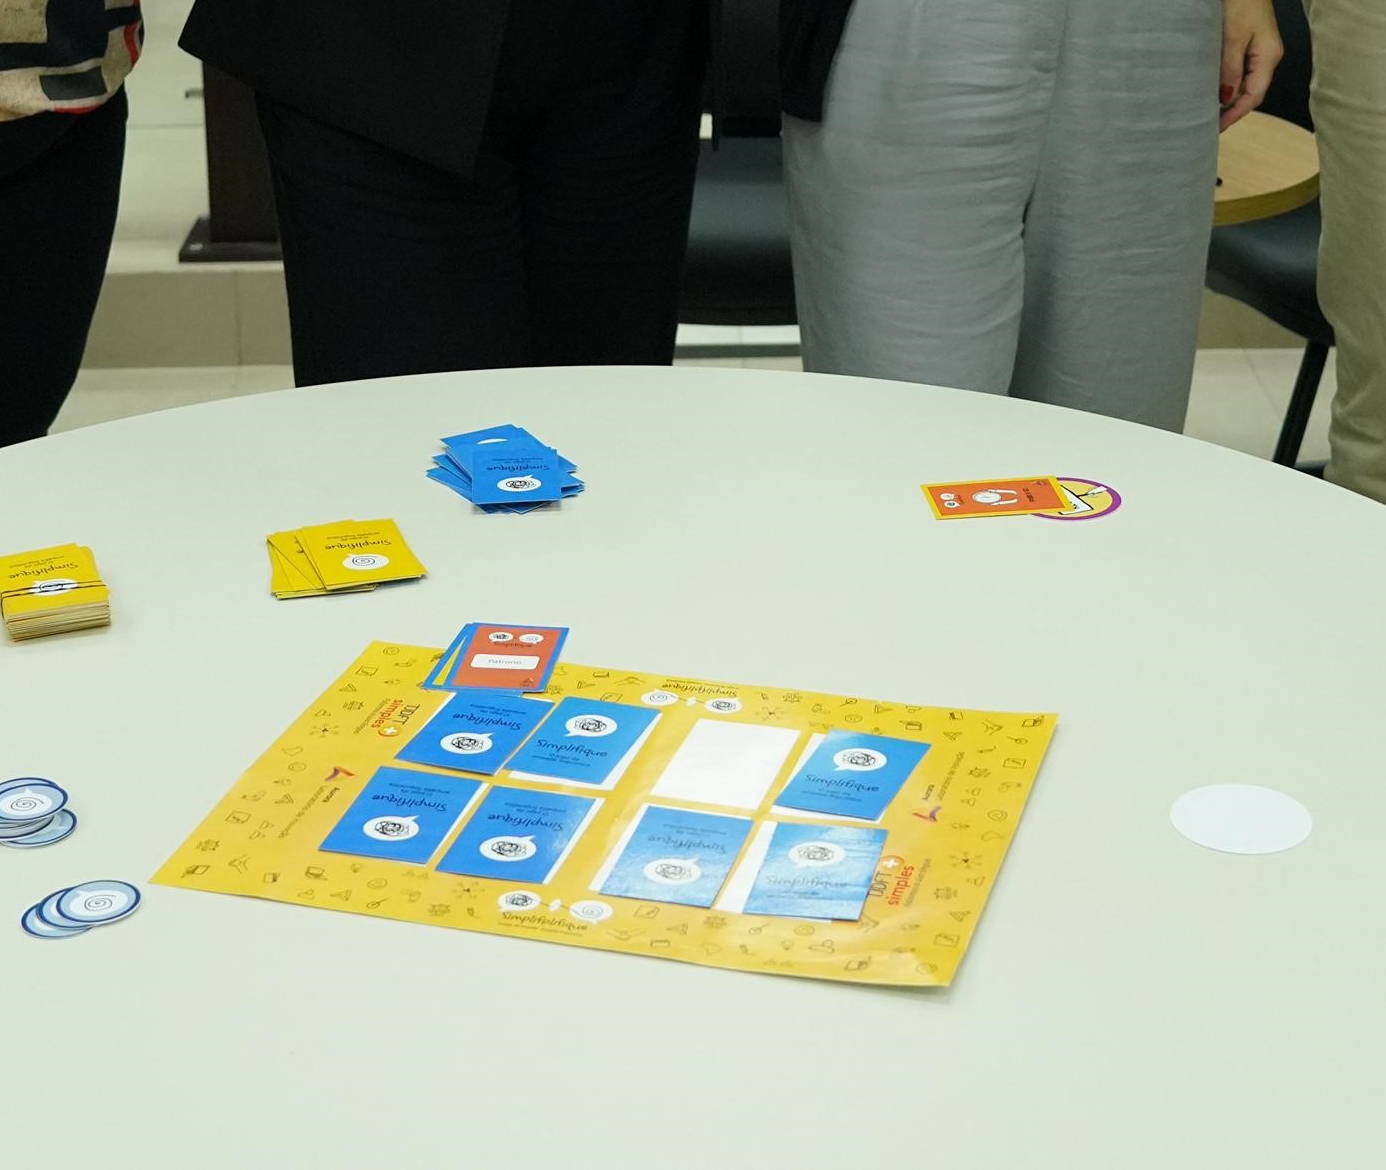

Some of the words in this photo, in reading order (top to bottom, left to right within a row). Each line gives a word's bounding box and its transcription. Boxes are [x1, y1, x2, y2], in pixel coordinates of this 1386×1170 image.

[325, 539, 391, 551] Simplifique
[7, 561, 78, 580] Simplifique
[452, 712, 522, 731] Simplifique
[536, 739, 608, 758] Simplifique
[805, 773, 880, 792] Simplifique
[371, 793, 446, 812] Simplifique
[487, 813, 564, 831] Simplifique
[647, 835, 726, 855] Simplifique
[887, 865, 916, 906] simples
